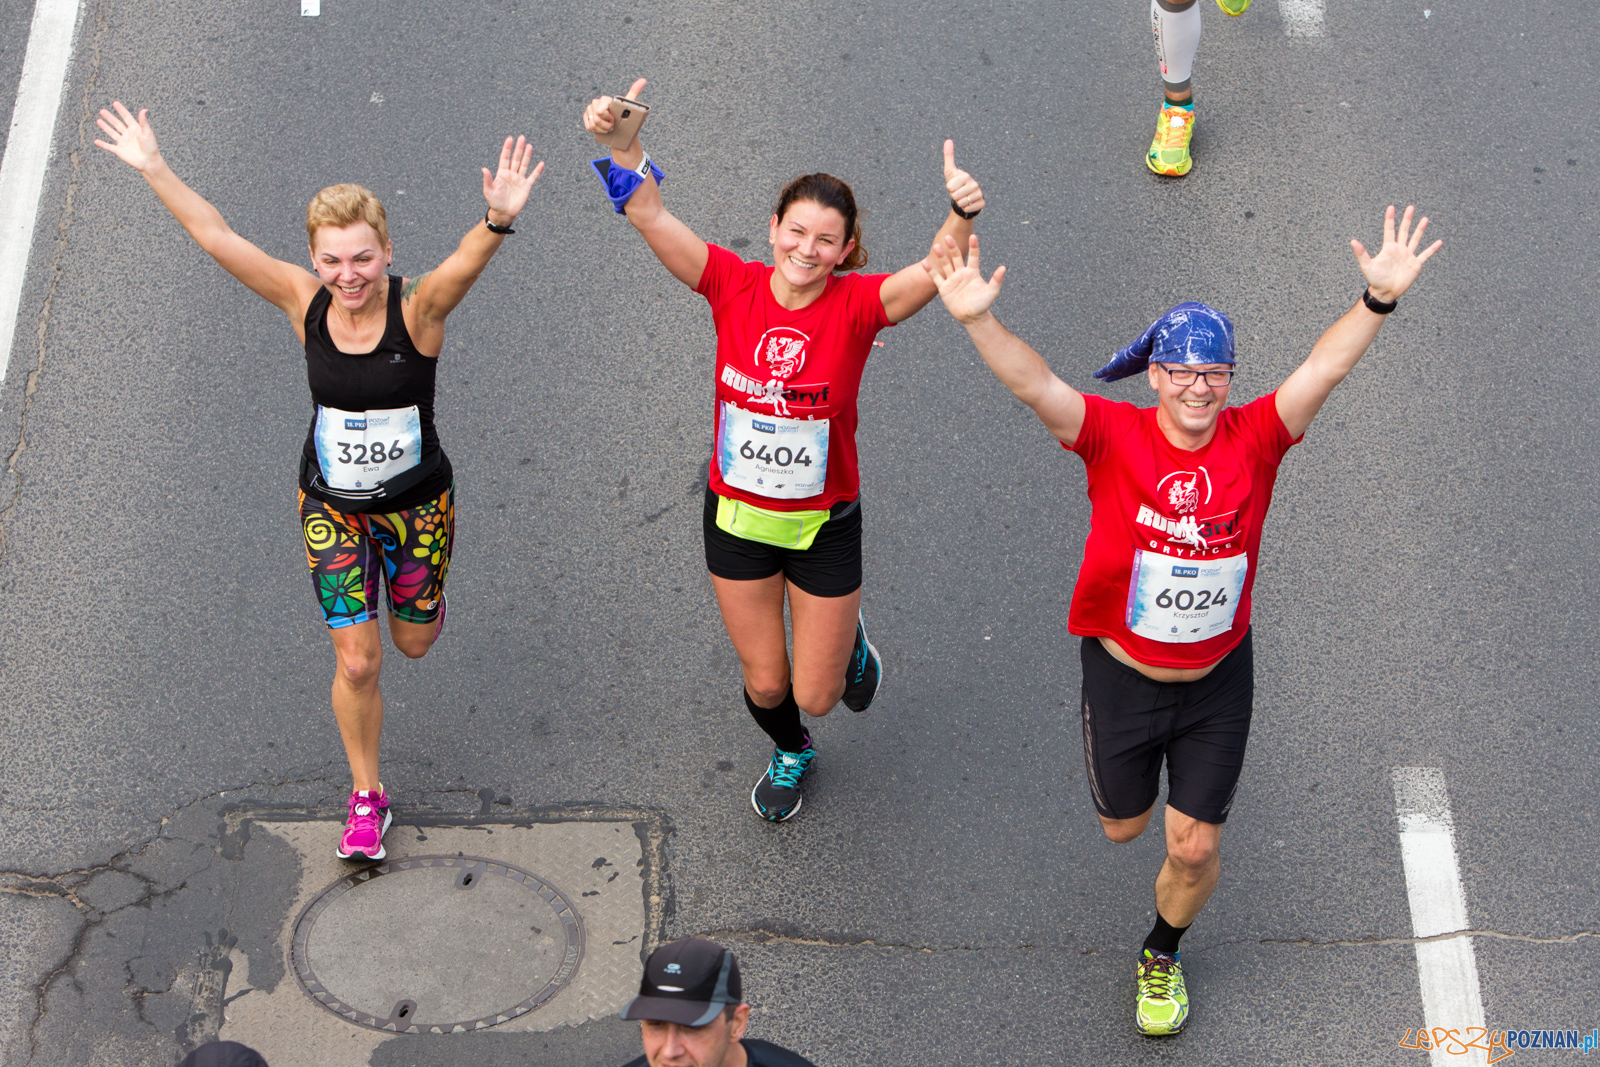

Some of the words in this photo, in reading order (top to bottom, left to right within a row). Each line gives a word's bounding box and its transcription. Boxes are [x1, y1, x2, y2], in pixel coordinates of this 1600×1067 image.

[720, 365, 763, 397] RUN
[783, 386, 830, 406] Gryf
[337, 440, 404, 465] 3286
[739, 440, 812, 467] 6404
[755, 464, 794, 475] Agnieszka
[1135, 505, 1182, 539] RUN
[1199, 511, 1240, 539] Gryf
[1149, 540, 1232, 557] GRYFICE
[1155, 587, 1228, 611] 6024
[1173, 610, 1210, 620] Krzysztof
